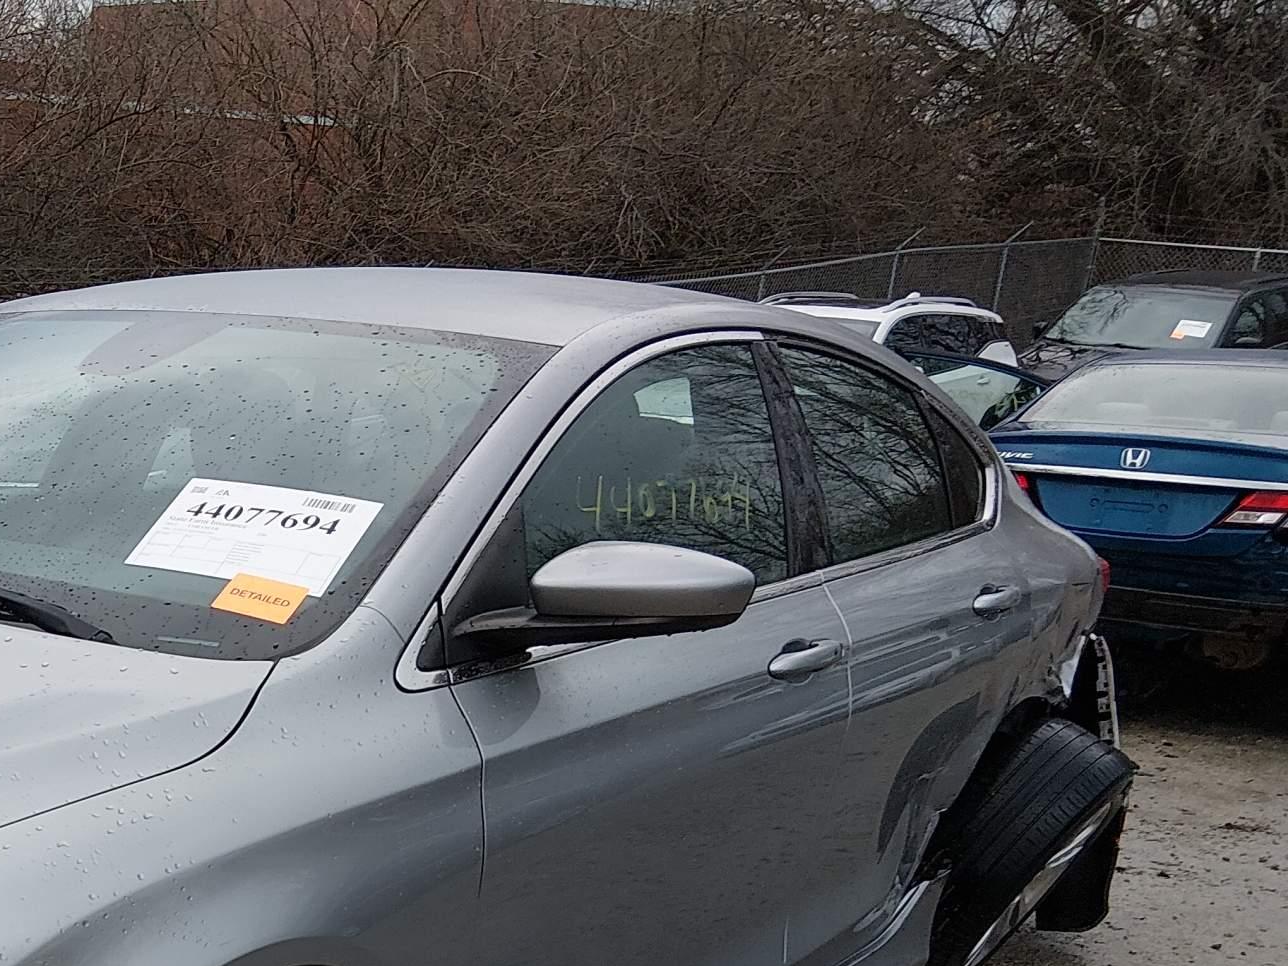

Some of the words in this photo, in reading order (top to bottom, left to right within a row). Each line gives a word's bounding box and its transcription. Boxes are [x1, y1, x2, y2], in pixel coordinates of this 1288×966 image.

[996, 451, 1034, 459] IVIC
[186, 501, 341, 535] 44077694
[229, 587, 291, 608] DETAILED
